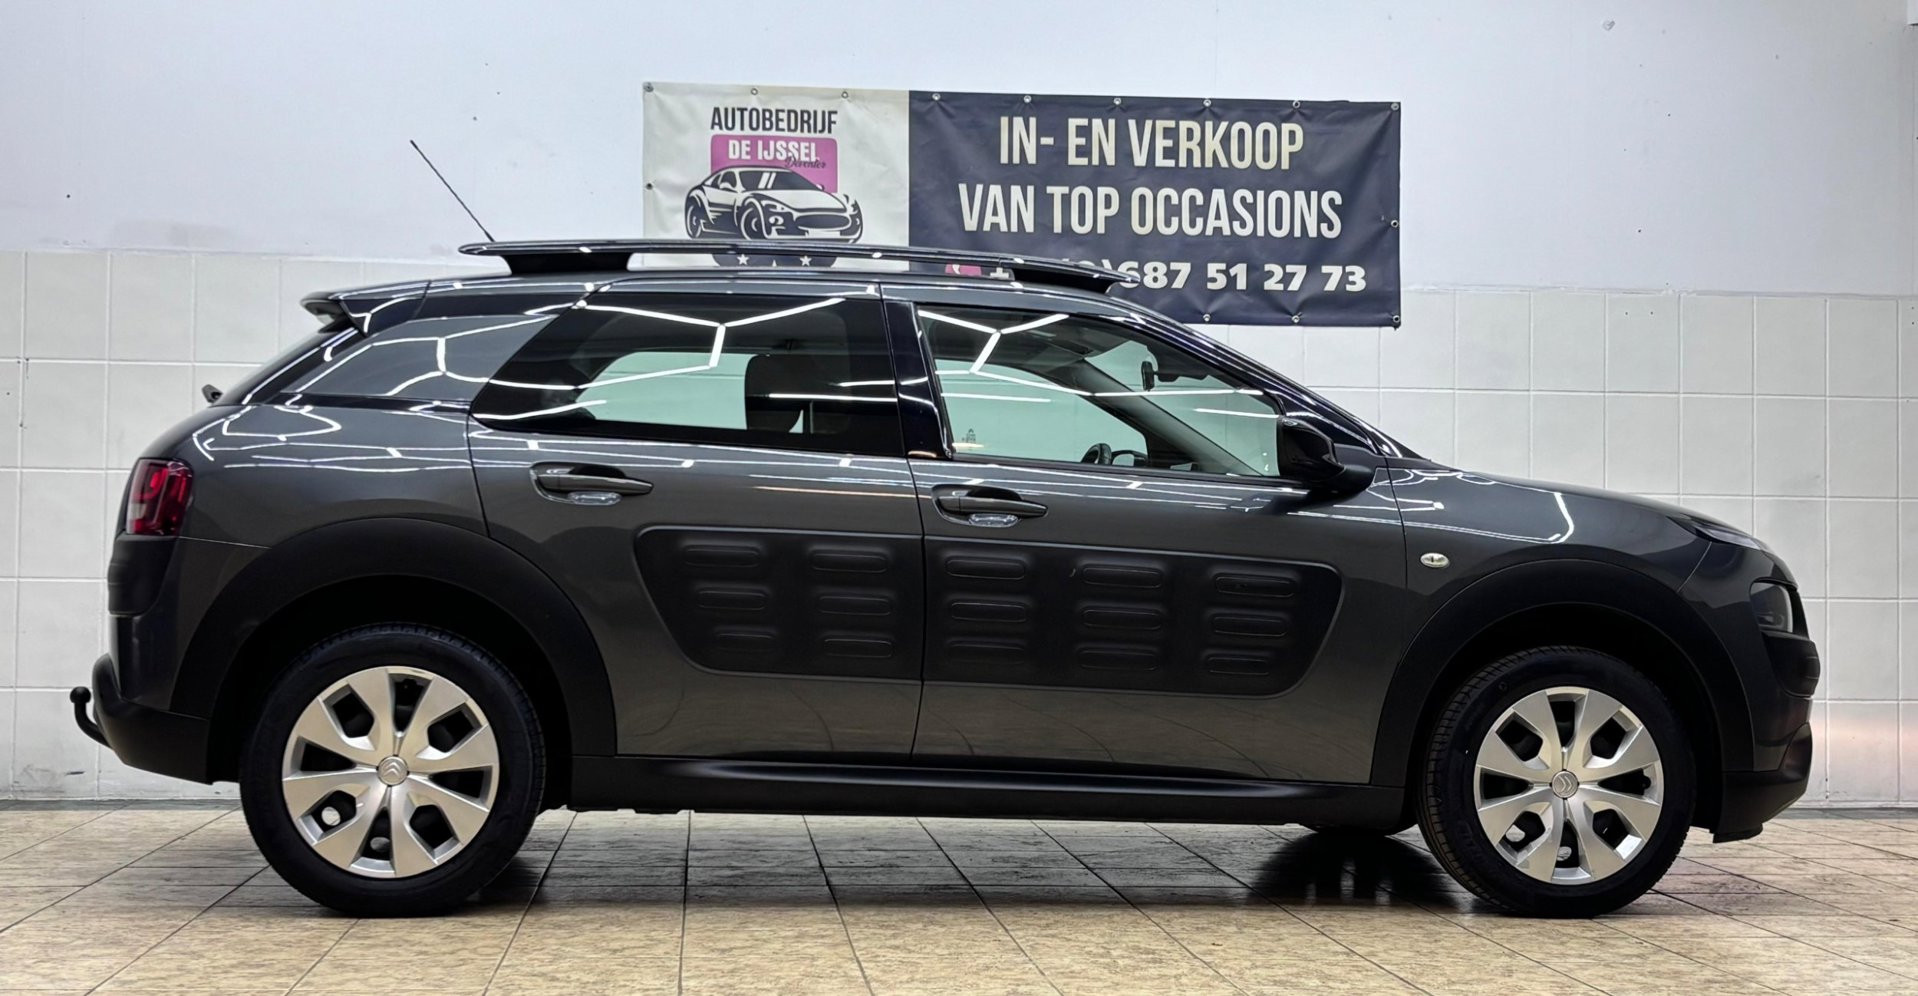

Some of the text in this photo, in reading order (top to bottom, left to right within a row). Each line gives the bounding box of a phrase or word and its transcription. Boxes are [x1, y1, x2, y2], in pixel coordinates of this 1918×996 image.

[710, 107, 838, 134] AUTOBEDRIJF
[729, 139, 819, 163] DE IJSSEL
[1000, 116, 1304, 170] IN- EN VERKOOP
[958, 183, 1343, 239] VAN TOP OCCASIONS
[1206, 262, 1248, 291] 51
[1263, 263, 1308, 292] 27
[1321, 265, 1367, 292] 73
